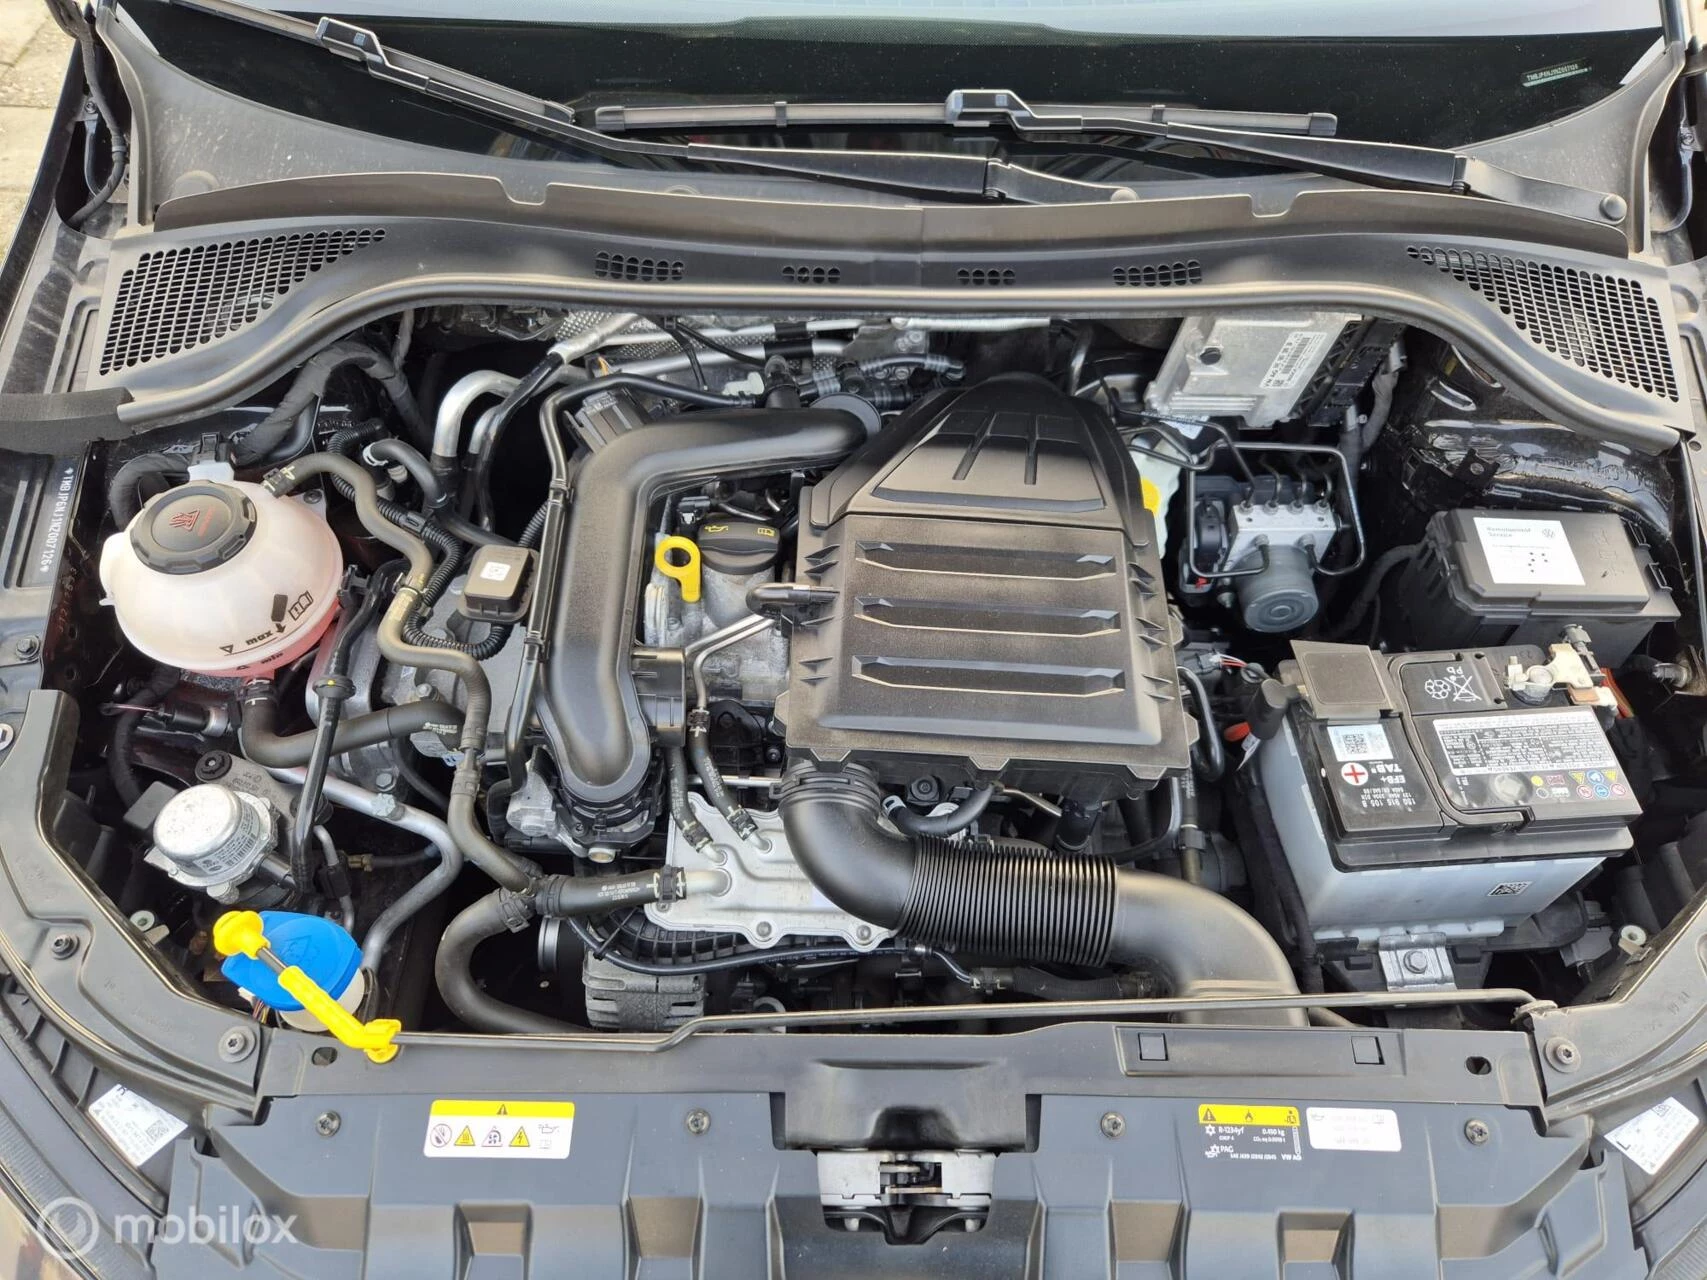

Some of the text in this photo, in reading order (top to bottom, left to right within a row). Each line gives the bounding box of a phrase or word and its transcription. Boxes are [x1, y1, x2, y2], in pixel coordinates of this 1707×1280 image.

[245, 630, 274, 646] max
[1446, 666, 1464, 675] Pb
[1380, 775, 1406, 784] EFB+
[1220, 1145, 1234, 1153] PAG
[1616, 1141, 1632, 1152] L
